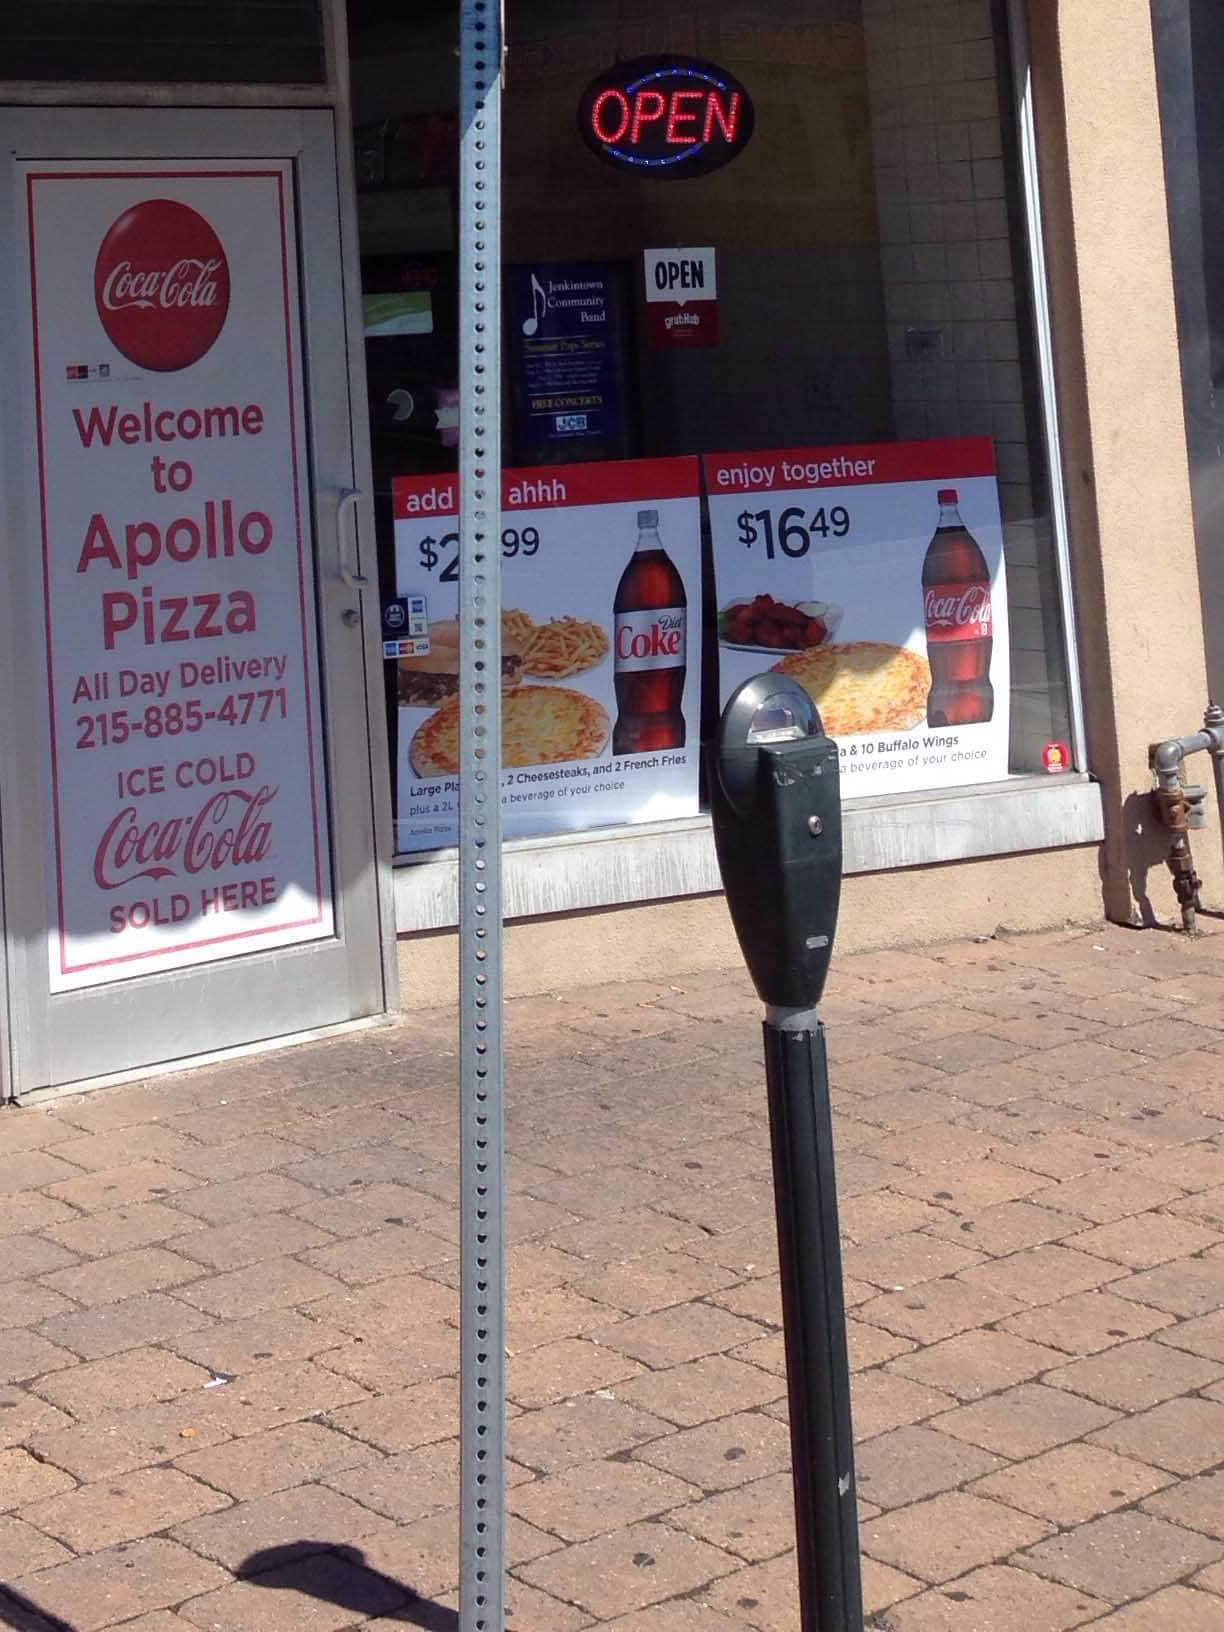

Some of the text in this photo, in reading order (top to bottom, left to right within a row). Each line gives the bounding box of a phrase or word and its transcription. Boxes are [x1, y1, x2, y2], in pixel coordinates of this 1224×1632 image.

[592, 90, 741, 145] OPEN
[103, 256, 224, 310] Coca-Cola
[548, 279, 604, 293] Jenkintown
[655, 260, 705, 290] OPEN
[547, 295, 605, 309] Community
[580, 310, 606, 323] Band
[72, 402, 264, 448] Welcome
[151, 455, 194, 494] to
[717, 456, 876, 488] enjoy together
[406, 479, 567, 512] add ahhh
[76, 499, 274, 580] Apollo
[102, 585, 257, 650] Pizza
[617, 624, 682, 660] Coke
[72, 654, 288, 704] All Day Delivery
[76, 688, 288, 749] 215-885-4771
[850, 757, 904, 774] beverage
[907, 755, 919, 767] of
[922, 753, 947, 767] your
[951, 749, 987, 763] choice
[861, 743, 874, 755] 10
[878, 738, 920, 753] Buffalo
[923, 735, 959, 749] Wings
[117, 752, 256, 799] ICE COLD
[410, 783, 442, 798] Large
[507, 774, 514, 785] 2
[516, 766, 592, 784] Cheesesteaks,
[592, 762, 612, 776] and
[615, 761, 622, 772] 2
[623, 756, 659, 771] French
[661, 754, 687, 767] Fries
[409, 802, 431, 817] plus
[433, 804, 440, 813] a
[441, 801, 454, 812] 2L
[510, 789, 555, 804] beverage
[557, 786, 568, 798] of
[570, 784, 592, 798] your
[594, 780, 625, 793] choice
[93, 784, 280, 890] Coca-Cola
[109, 875, 277, 934] SOLD HERE
